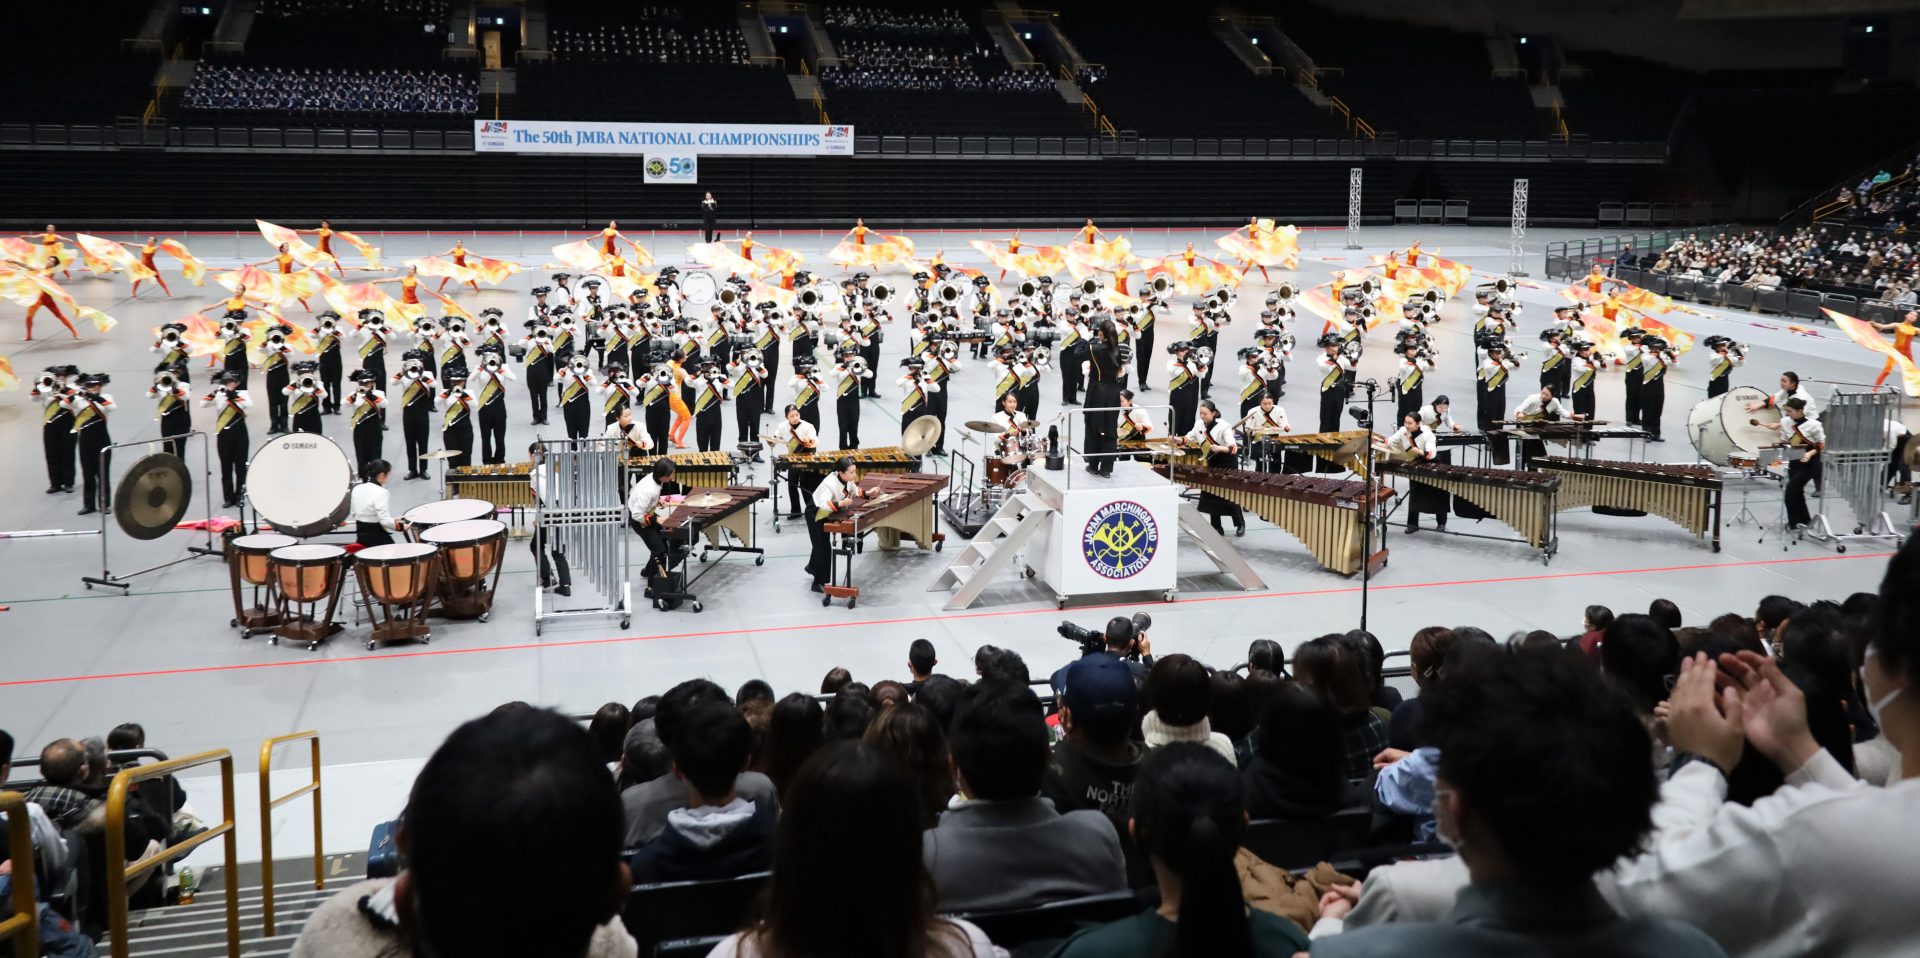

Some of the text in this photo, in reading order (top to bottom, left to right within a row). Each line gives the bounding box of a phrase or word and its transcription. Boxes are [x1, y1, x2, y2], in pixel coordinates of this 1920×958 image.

[513, 129, 820, 147] The 50th JMBA NATIONAL CHAMPIONSHIPS
[1084, 502, 1157, 545] JAPAN MARCHINGBAND
[1090, 555, 1149, 578] ASSOCIATION
